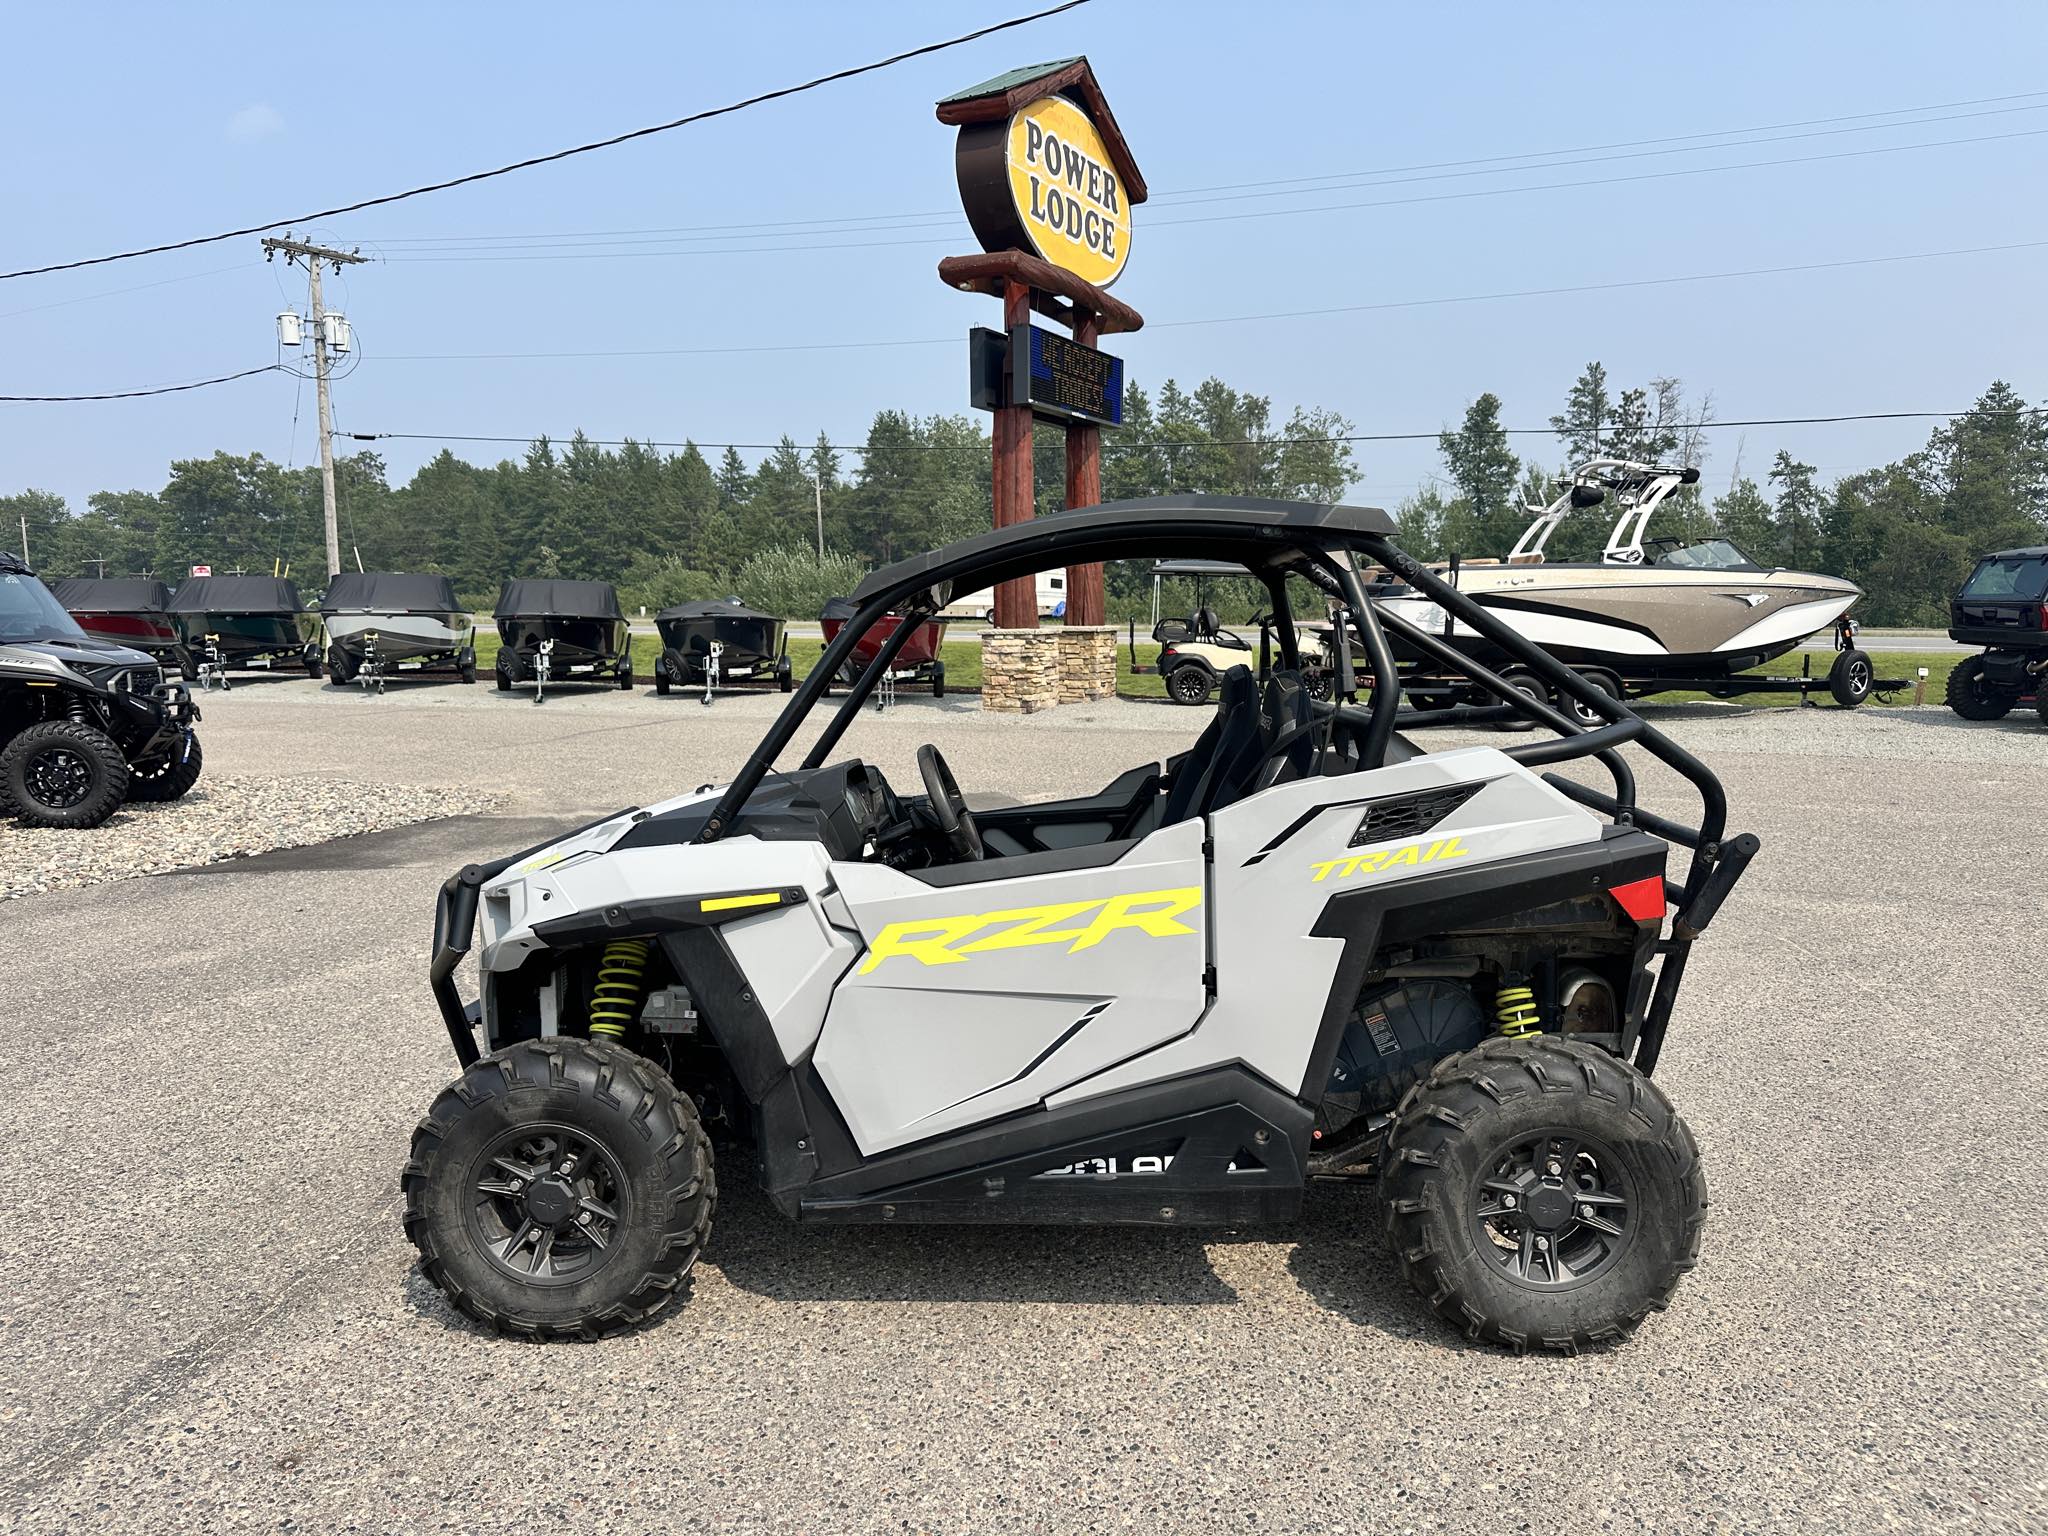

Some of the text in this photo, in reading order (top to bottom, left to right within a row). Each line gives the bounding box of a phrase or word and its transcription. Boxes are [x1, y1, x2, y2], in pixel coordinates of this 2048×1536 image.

[1026, 119, 1118, 215] POWER
[1030, 176, 1116, 259] LODGE
[1042, 334, 1110, 386] WE ACCEPT
[1052, 371, 1104, 414] TRADES!
[1310, 836, 1470, 882] TRAIL
[857, 885, 1202, 976] RZR
